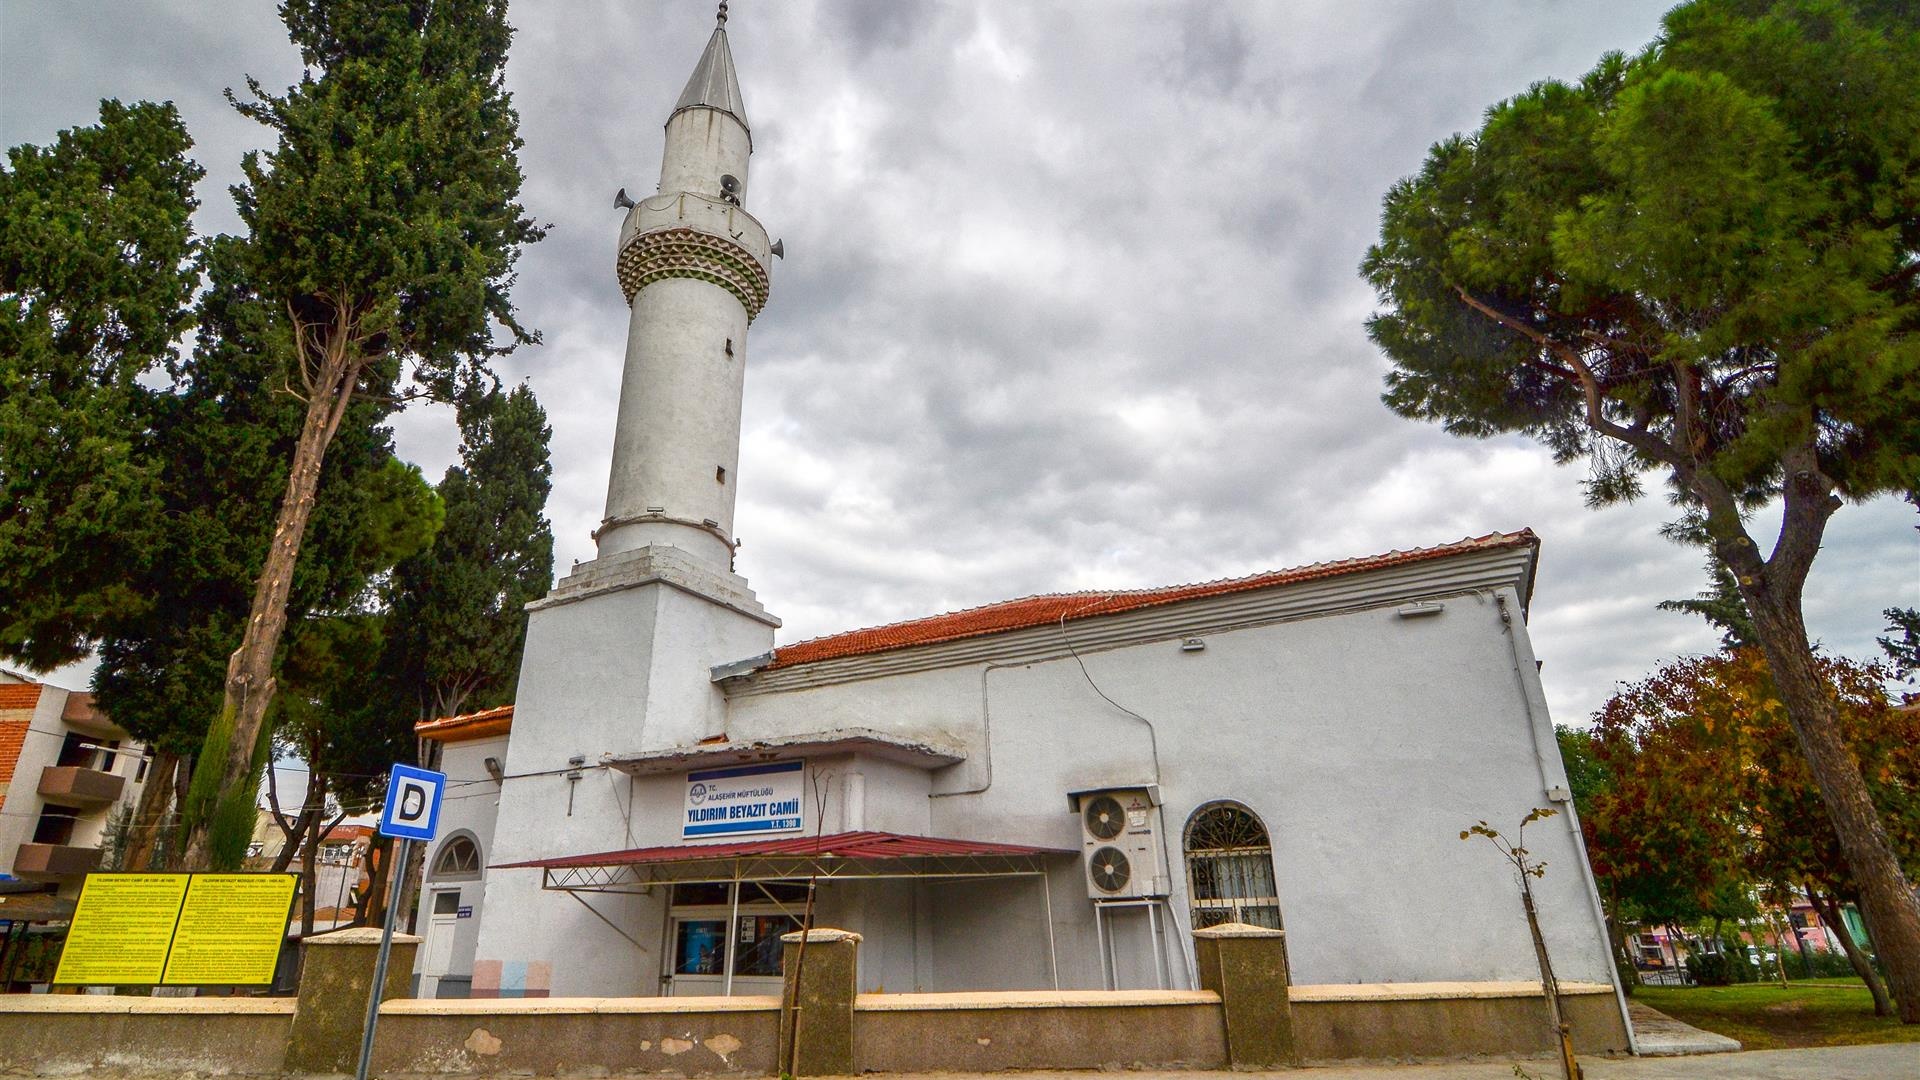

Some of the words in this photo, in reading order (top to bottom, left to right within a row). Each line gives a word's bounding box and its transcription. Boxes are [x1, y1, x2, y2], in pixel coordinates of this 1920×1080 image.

[399, 783, 426, 821] D
[708, 792, 736, 801] ALAŞEHİR
[737, 787, 773, 798] MÜFTÜLÜĞÜ
[687, 807, 727, 822] YILDIRIM
[729, 803, 766, 819] BEYAZIT
[769, 798, 799, 815] CAMİİ
